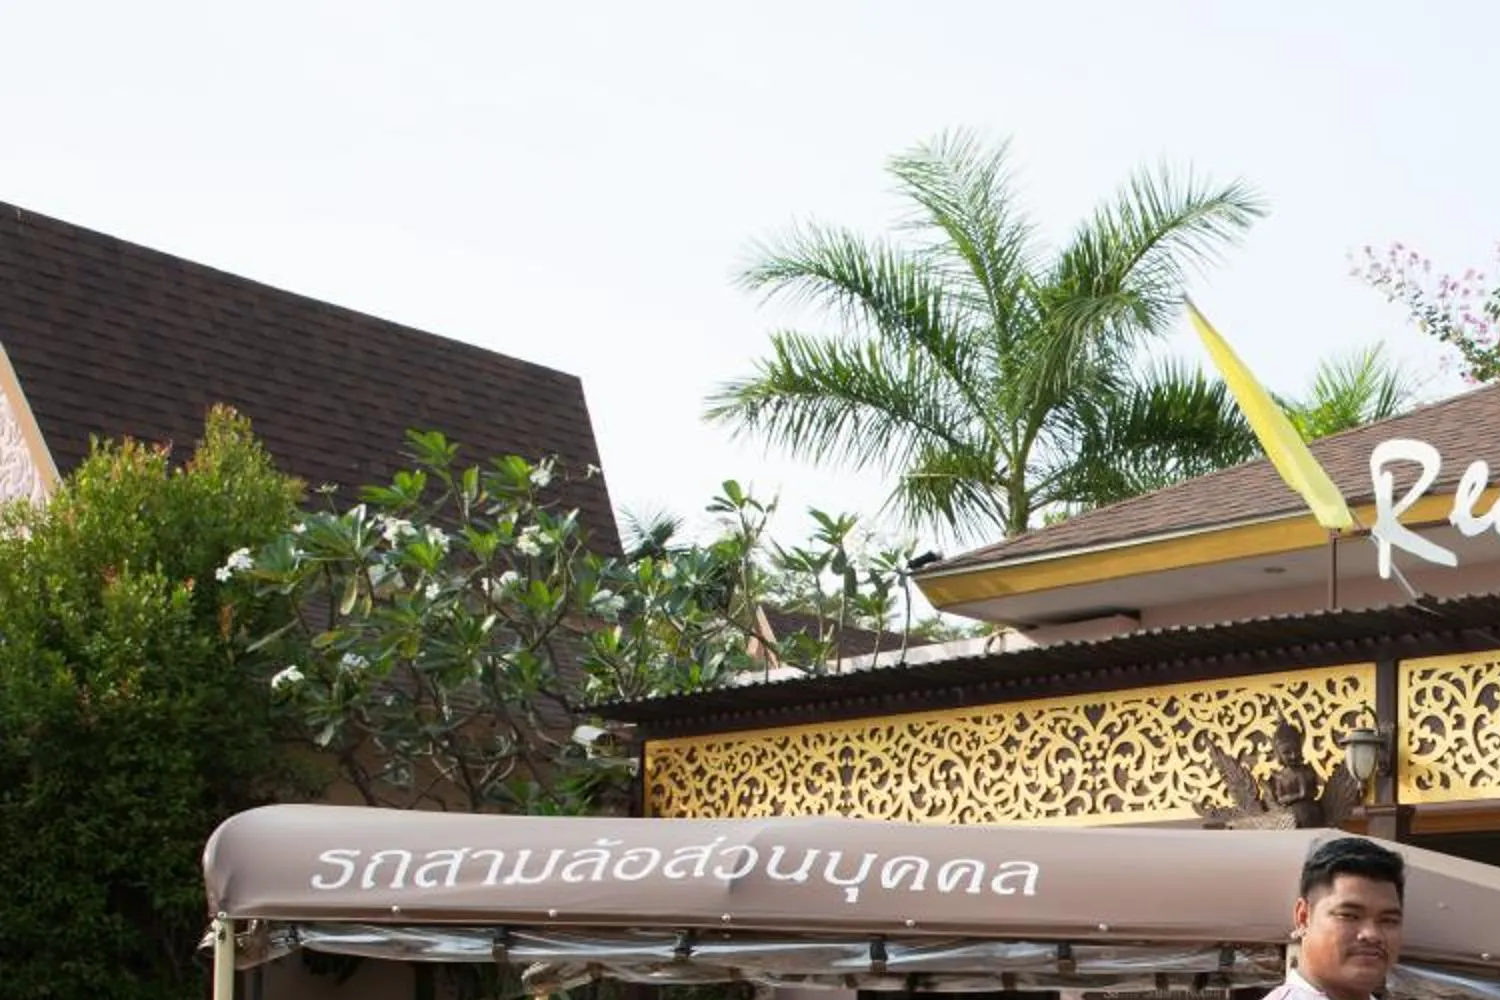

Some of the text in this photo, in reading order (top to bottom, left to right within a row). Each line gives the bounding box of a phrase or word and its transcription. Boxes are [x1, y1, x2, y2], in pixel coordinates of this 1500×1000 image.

[311, 835, 1041, 903] รถสามล้อส่วนบุคคล
